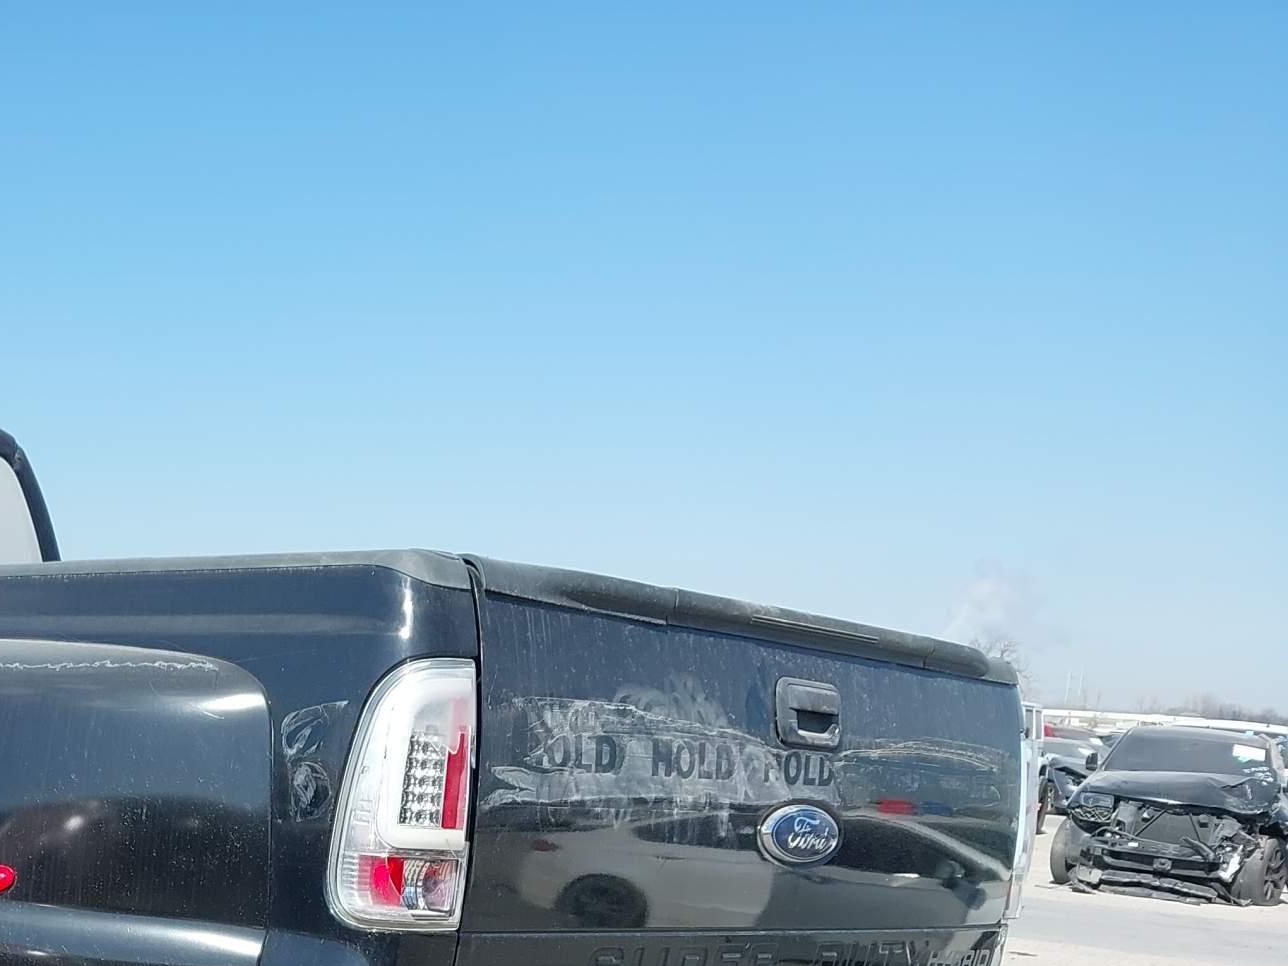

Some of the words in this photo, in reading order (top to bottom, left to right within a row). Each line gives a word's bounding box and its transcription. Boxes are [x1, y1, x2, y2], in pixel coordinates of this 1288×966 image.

[534, 735, 625, 774] OLD
[651, 733, 736, 781] HOLD
[787, 816, 829, 850] Ford
